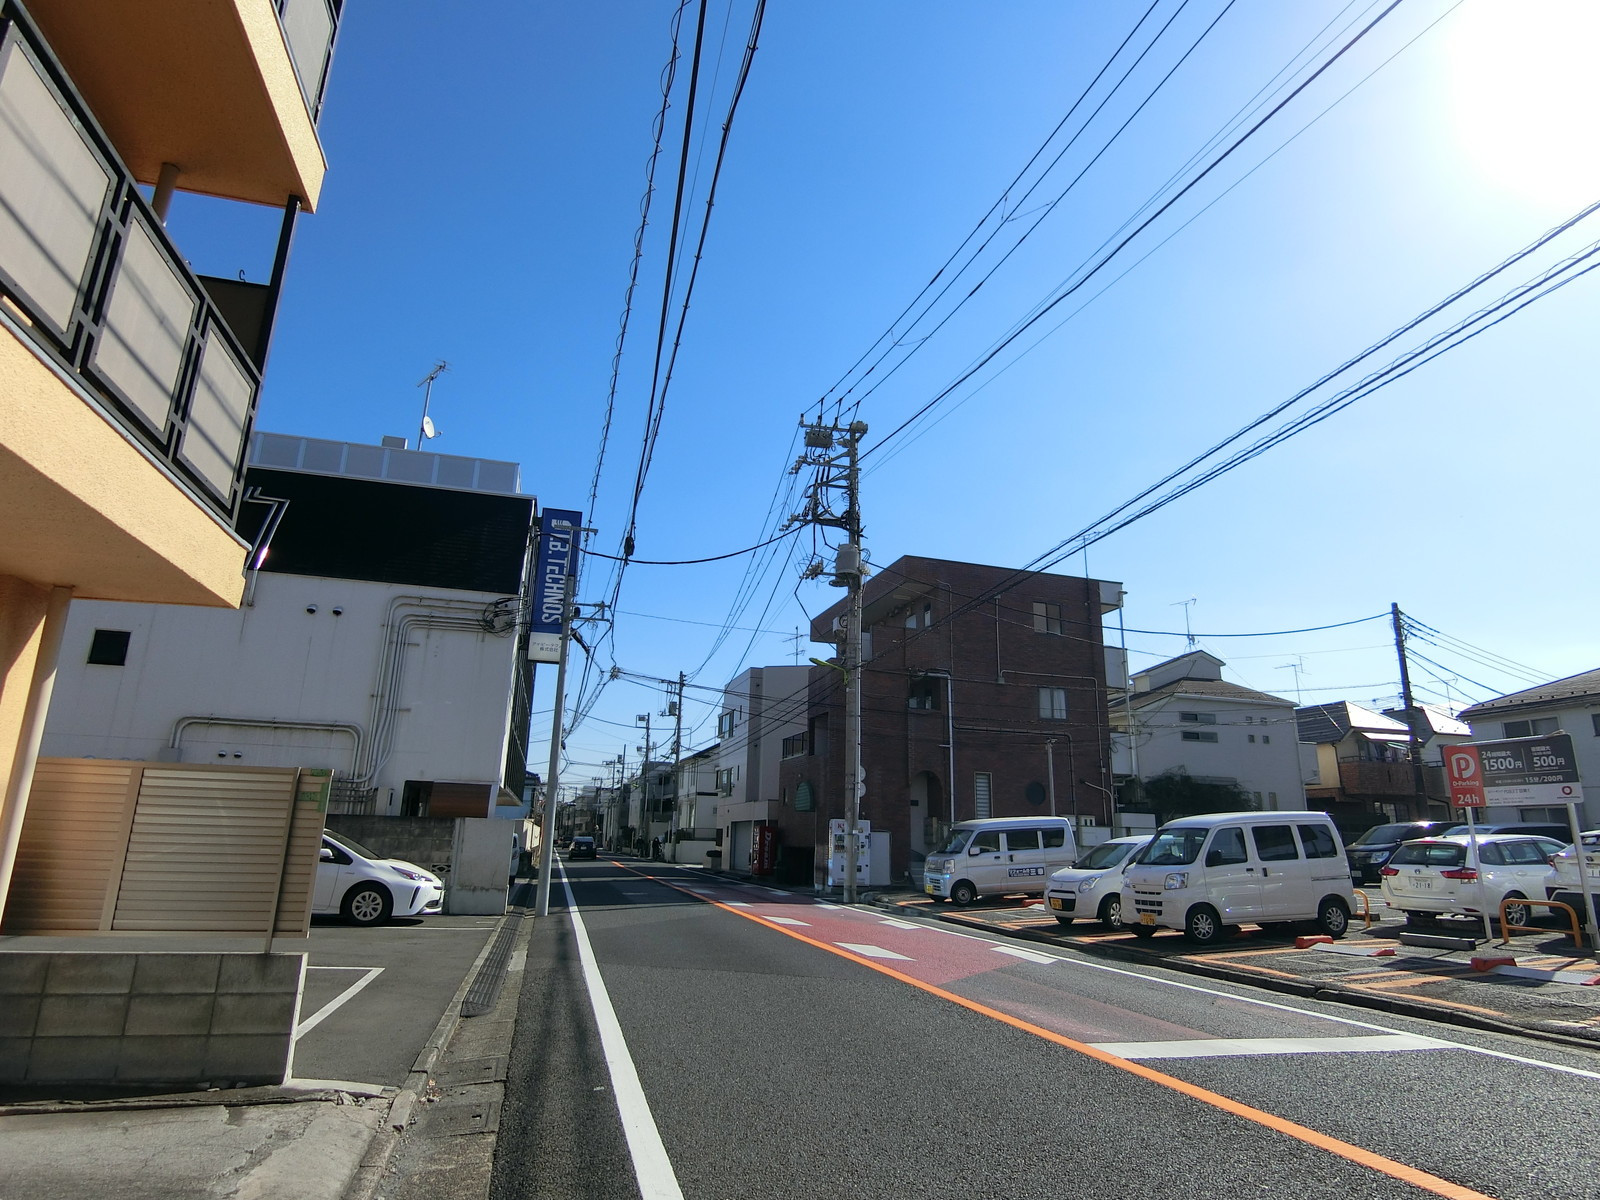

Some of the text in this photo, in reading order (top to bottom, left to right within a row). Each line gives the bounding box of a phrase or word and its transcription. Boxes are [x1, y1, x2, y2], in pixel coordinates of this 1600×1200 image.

[542, 558, 567, 624] TECHNOS
[1482, 757, 1523, 771] 1500円
[1533, 755, 1565, 767] 500円
[1525, 775, 1563, 783] 15分/200円
[1457, 794, 1480, 804] 24h
